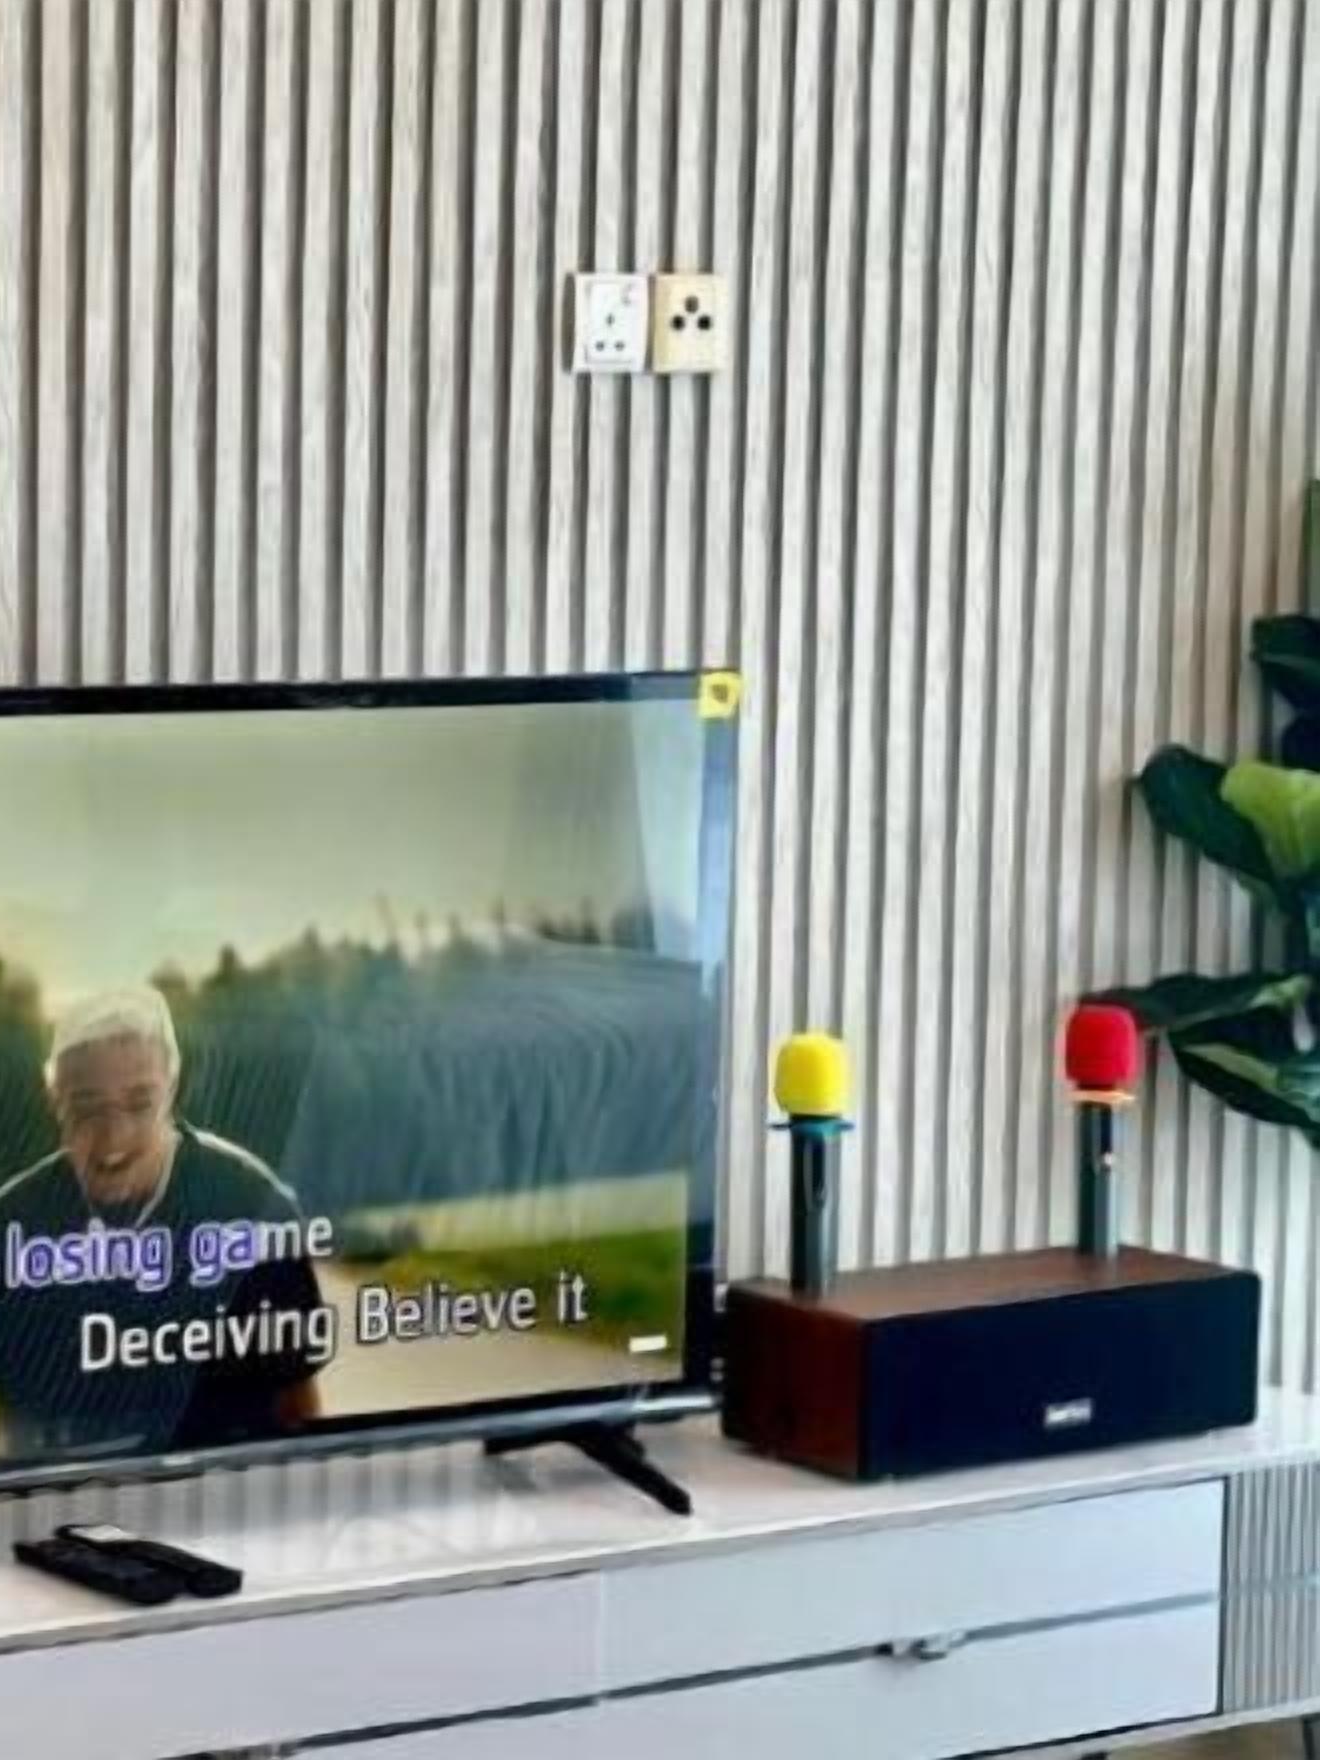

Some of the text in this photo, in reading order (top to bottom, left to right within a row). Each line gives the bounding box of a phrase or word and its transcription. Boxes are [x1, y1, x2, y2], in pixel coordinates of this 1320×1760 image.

[6, 1218, 171, 1291] losing
[188, 1216, 334, 1286] game
[80, 1272, 588, 1372] Deceiving Believe it
